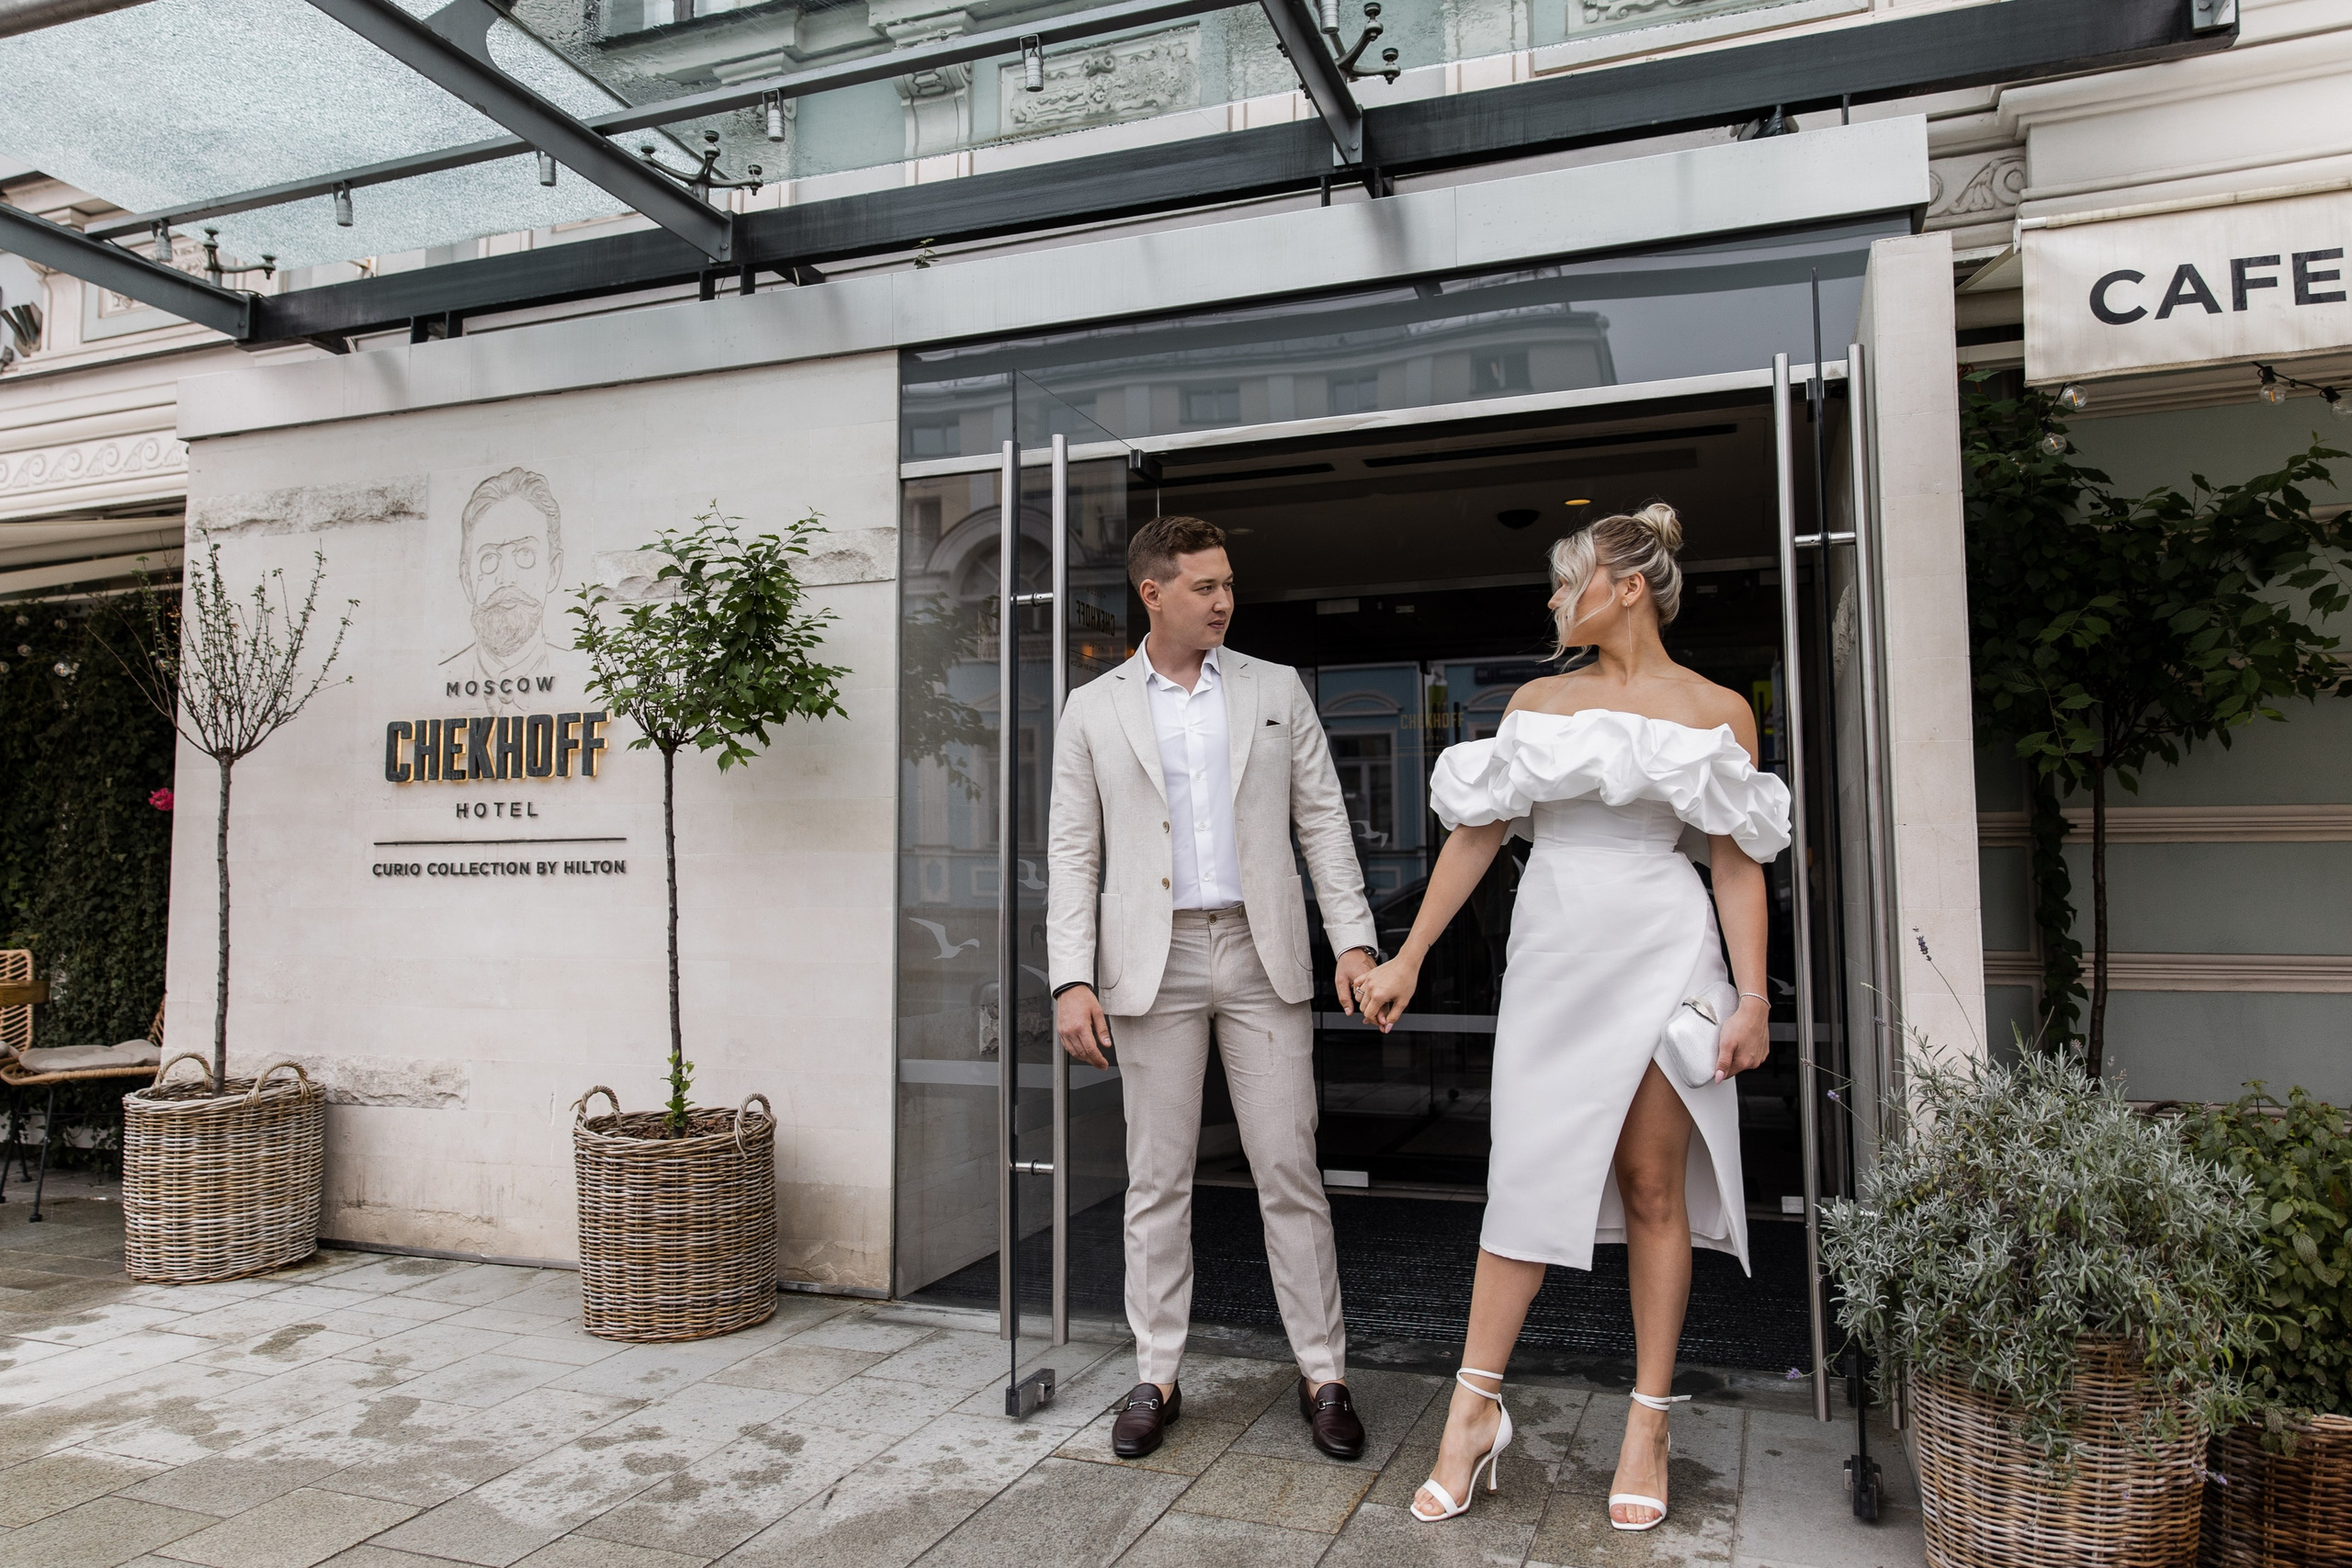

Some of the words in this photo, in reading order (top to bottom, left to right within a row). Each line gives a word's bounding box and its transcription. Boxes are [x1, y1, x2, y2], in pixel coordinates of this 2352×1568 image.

[2089, 247, 2347, 326] CAFE
[447, 676, 555, 696] MOSCOW
[1400, 712, 1464, 729] CHEKHOFF
[385, 712, 611, 783] CHEKHOFF
[457, 802, 539, 818] HOTEL
[372, 863, 422, 876] CURIO
[426, 862, 531, 875] COLLECTION
[537, 861, 558, 874] BY
[563, 860, 627, 874] HILTON
